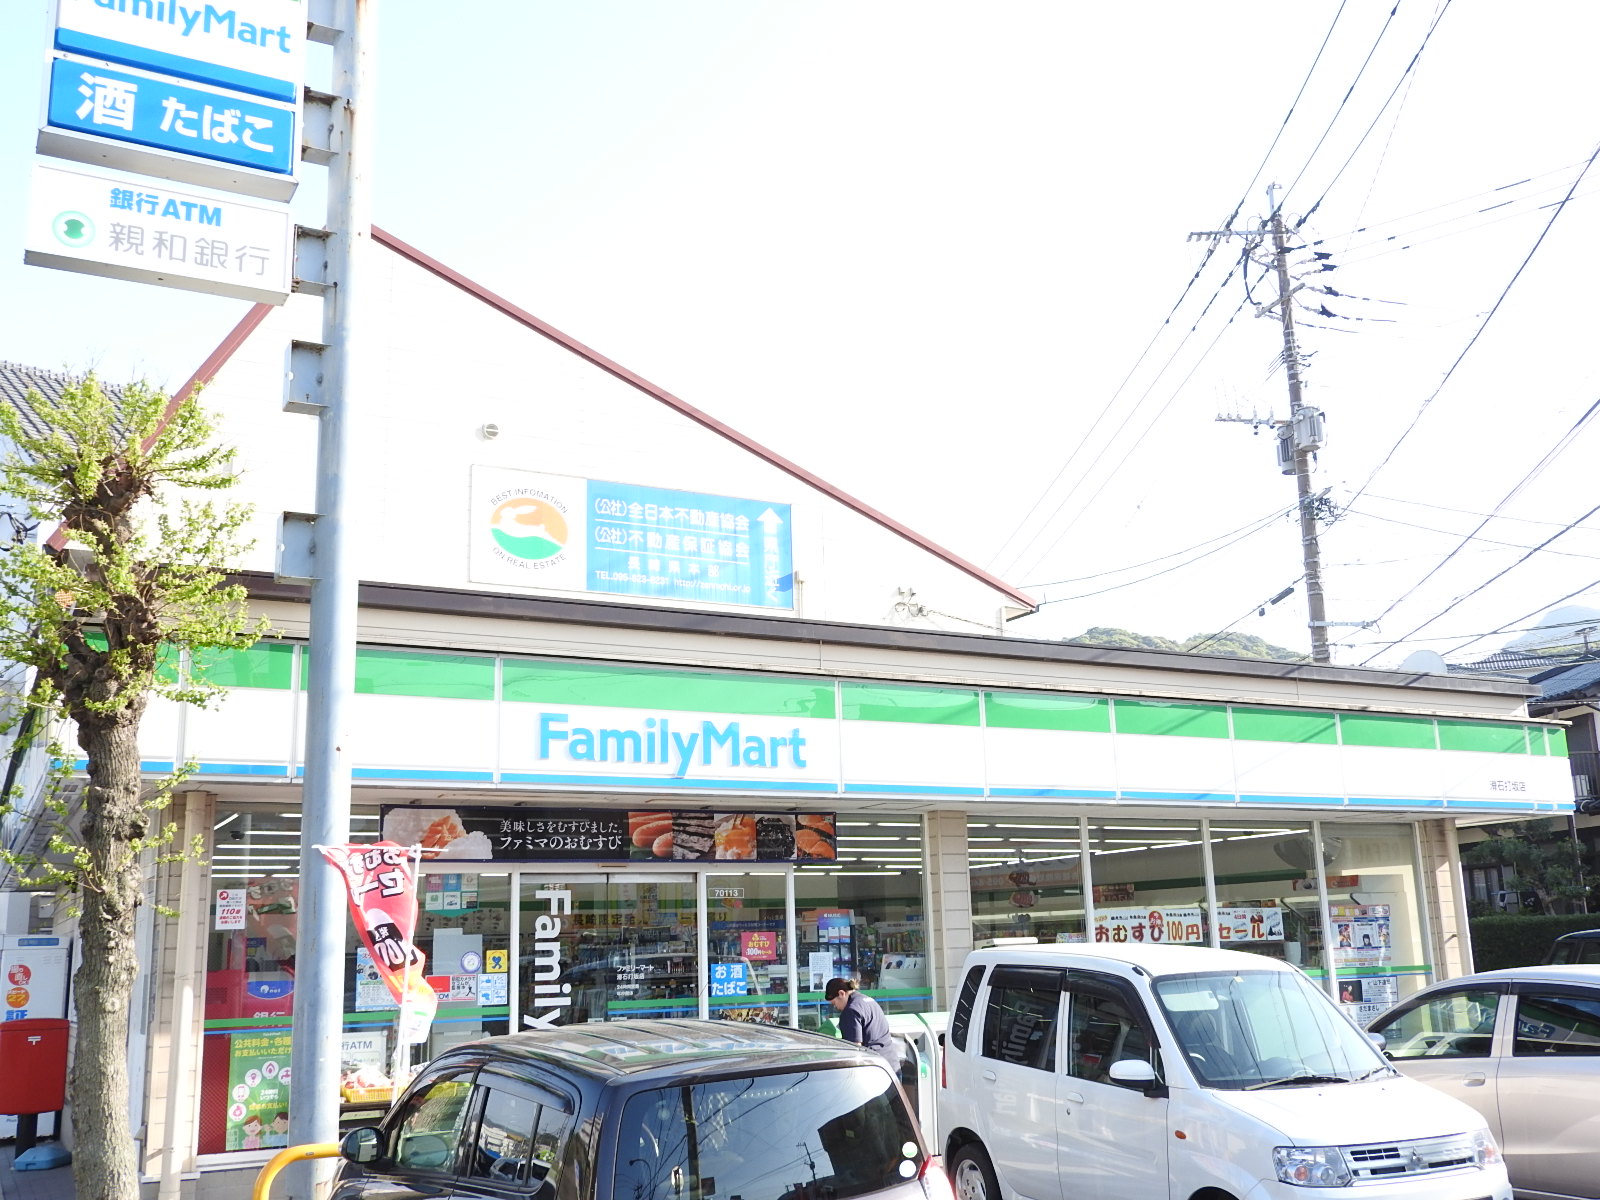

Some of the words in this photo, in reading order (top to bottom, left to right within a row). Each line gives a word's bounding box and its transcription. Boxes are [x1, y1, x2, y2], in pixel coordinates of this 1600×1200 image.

[90, 0, 292, 53] amilyMart
[76, 72, 138, 131] 酒
[160, 97, 274, 153] たばこ
[110, 188, 222, 227] 銀行ATM
[109, 222, 270, 276] 親和銀行
[490, 489, 512, 506] BEST
[492, 546, 506, 560] ON
[506, 556, 531, 569] REAL
[533, 553, 567, 570] ESTATE
[538, 712, 808, 779] FamilyMart
[500, 820, 623, 834] 美味しさをむすびました。
[500, 835, 622, 850] ファミマのおむすび
[714, 889, 739, 897] 70113
[1218, 922, 1265, 940] セール
[616, 964, 654, 972] ファミリーマート
[715, 964, 743, 979] お酒
[711, 981, 747, 996] たばこ
